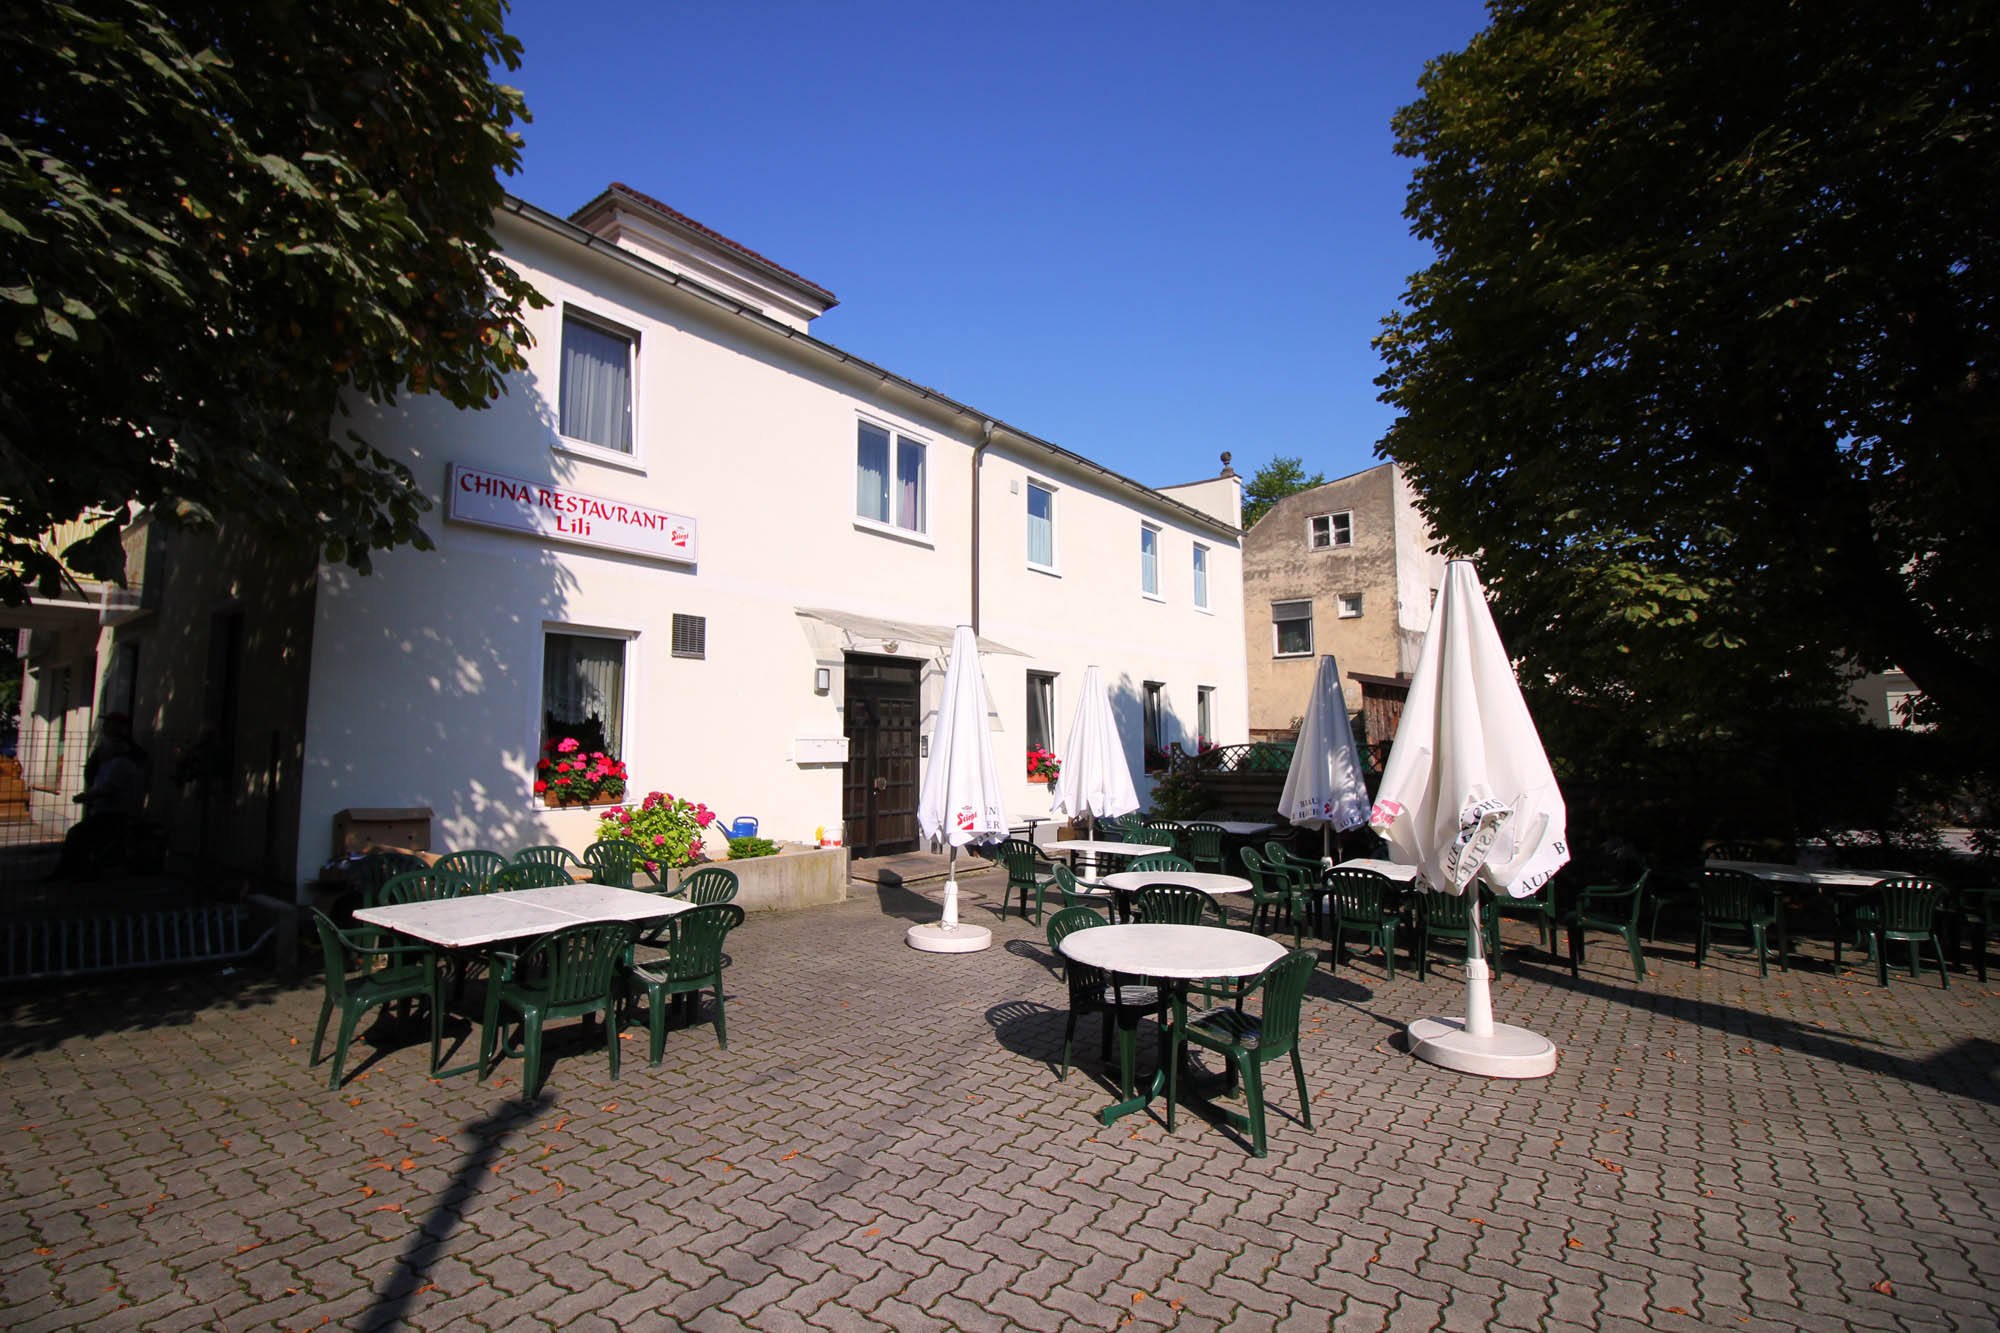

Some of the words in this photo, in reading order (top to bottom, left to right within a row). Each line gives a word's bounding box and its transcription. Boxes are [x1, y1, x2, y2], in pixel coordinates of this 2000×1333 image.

[460, 473, 532, 505] CHINA
[539, 489, 668, 532] RESTAURANT
[556, 515, 591, 536] Lili
